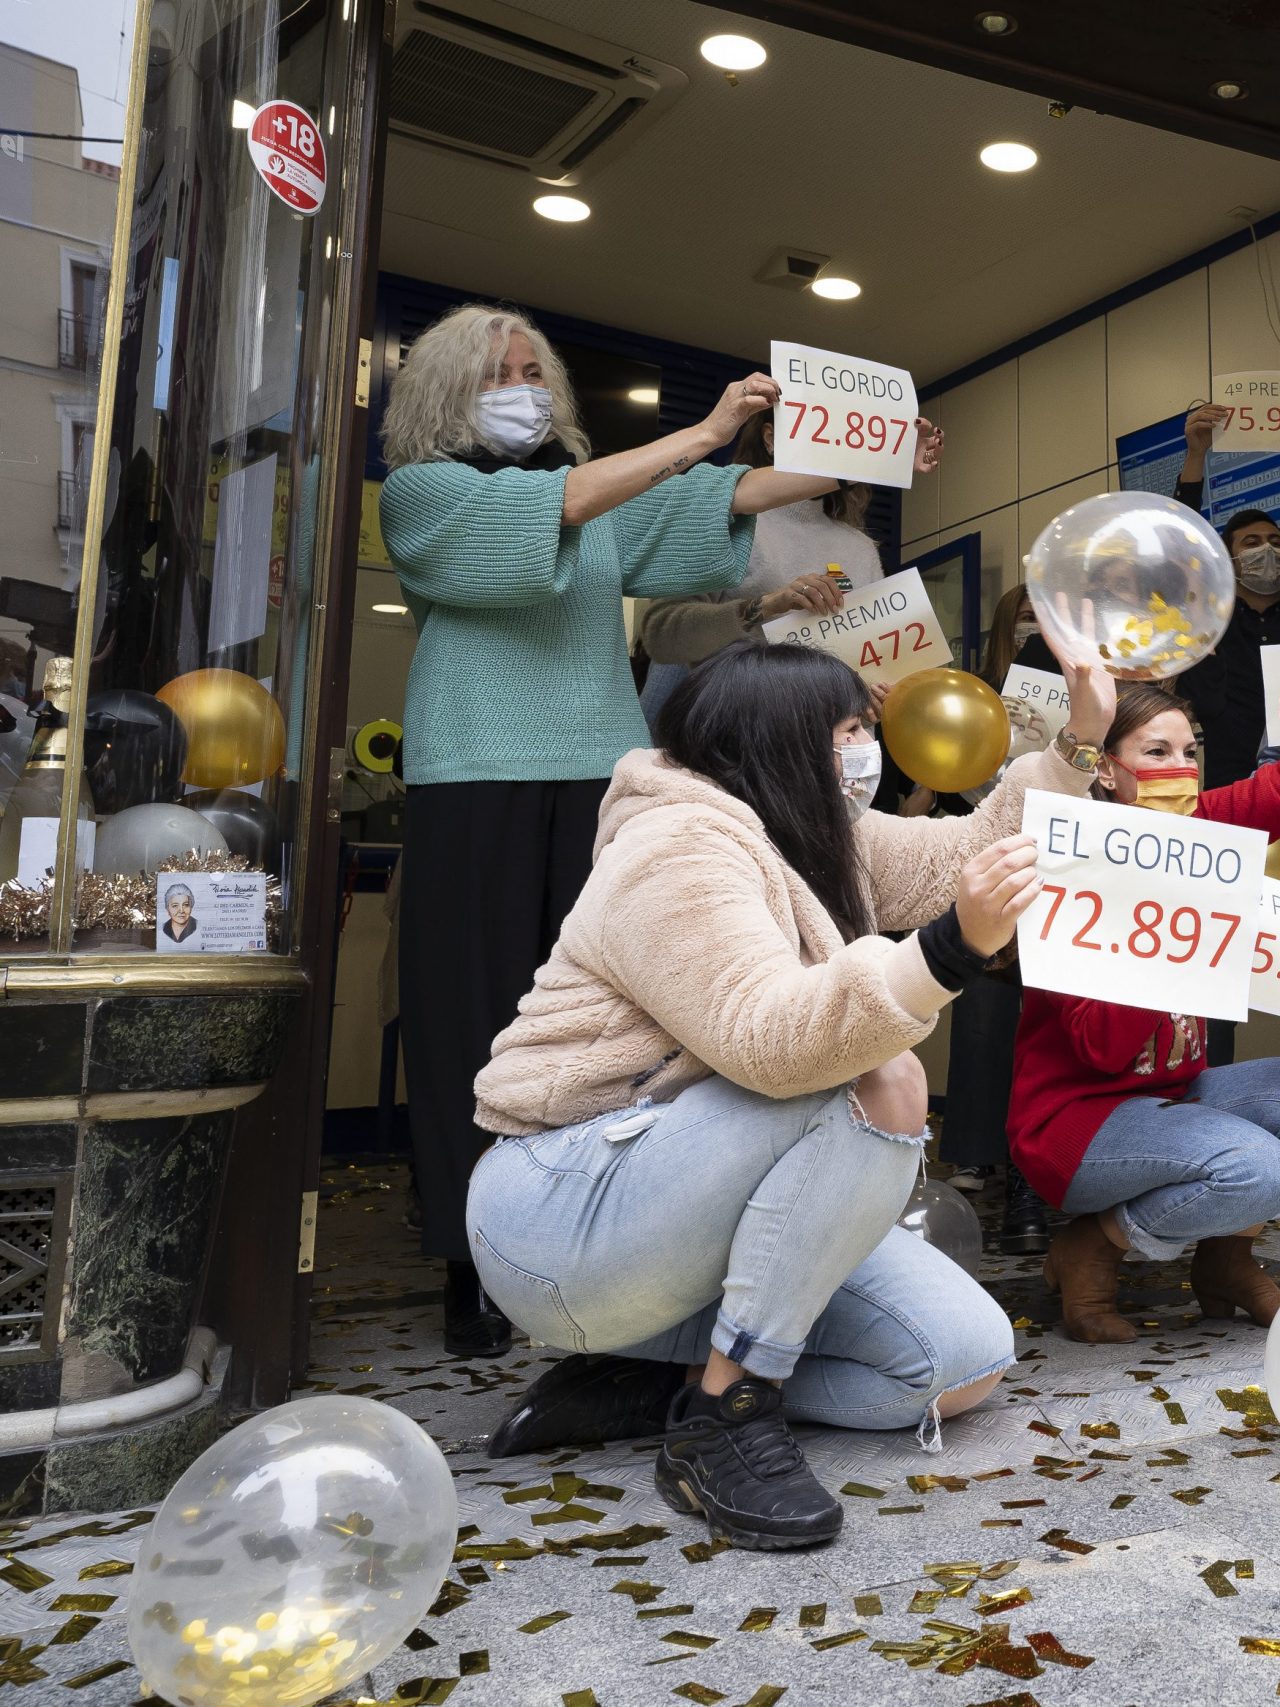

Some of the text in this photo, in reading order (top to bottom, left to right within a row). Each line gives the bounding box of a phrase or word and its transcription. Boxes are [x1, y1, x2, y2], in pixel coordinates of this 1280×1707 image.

[272, 115, 315, 158] +18
[789, 358, 903, 401] EL GORDO
[1224, 382, 1243, 396] 4º
[784, 401, 908, 455] 72.897
[787, 590, 908, 645] 3º PREMIO
[859, 622, 934, 667] 472
[1017, 681, 1041, 699] 5º
[1048, 816, 1242, 884] EL GORDO
[1039, 884, 1242, 969] 72.897
